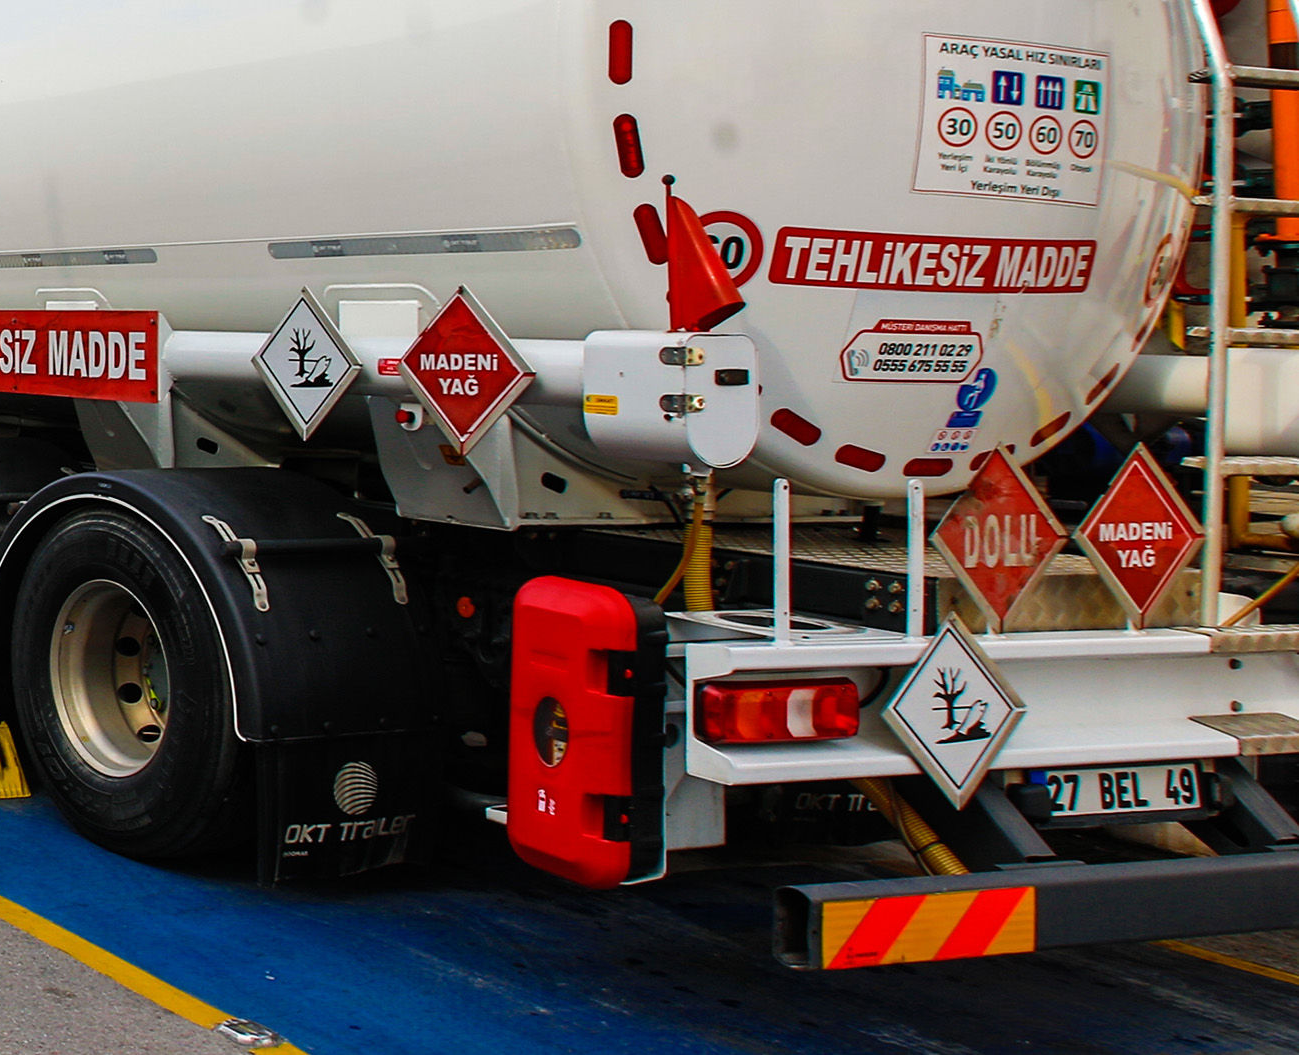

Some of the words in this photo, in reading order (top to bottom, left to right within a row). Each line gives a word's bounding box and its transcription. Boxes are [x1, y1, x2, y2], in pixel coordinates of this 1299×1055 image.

[939, 42, 979, 59] ARAÇ
[982, 46, 1023, 61] YASAL
[1025, 50, 1046, 63] HIZ
[1048, 52, 1102, 71] SINIRLARI
[945, 118, 972, 136] 30
[992, 122, 1017, 140] 50
[1035, 126, 1058, 144] 60
[1074, 130, 1094, 148] 70
[970, 180, 1018, 194] Yerleşim
[1020, 183, 1040, 195] Yeri
[1041, 185, 1061, 198] Dışı
[993, 245, 1093, 289] MADDE
[48, 330, 147, 381] MADDE
[878, 342, 913, 356] 0800
[913, 343, 938, 357] 211
[939, 344, 956, 357] 02
[956, 344, 974, 357] 29
[873, 358, 908, 372] 0555
[908, 359, 934, 372] 675
[933, 360, 951, 372] 55
[951, 360, 969, 373] 55
[438, 374, 479, 397] YAĞ
[964, 514, 1039, 569] DOLU
[1117, 545, 1156, 568] YAĞ
[1047, 774, 1080, 812] 27
[1099, 770, 1148, 810] BEL
[1165, 767, 1196, 805] 49
[795, 792, 842, 812] OKT
[285, 823, 332, 844] OKT
